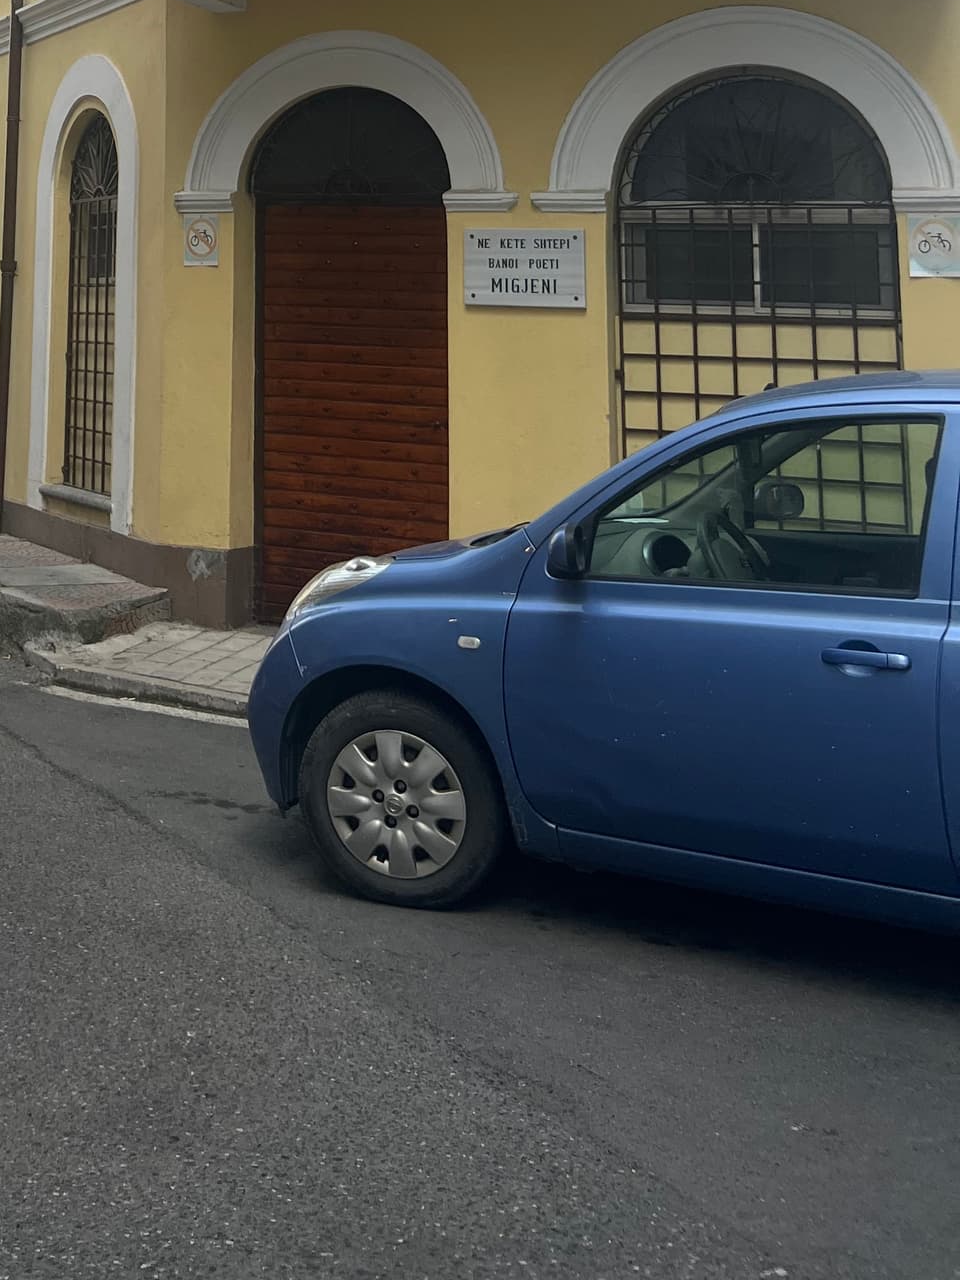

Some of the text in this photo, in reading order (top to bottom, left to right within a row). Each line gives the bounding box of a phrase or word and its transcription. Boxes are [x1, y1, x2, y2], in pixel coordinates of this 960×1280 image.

[477, 238, 570, 249] NE KETE SHTEPI
[488, 258, 559, 269] BANOI POETI
[491, 278, 557, 294] MIGJENI
